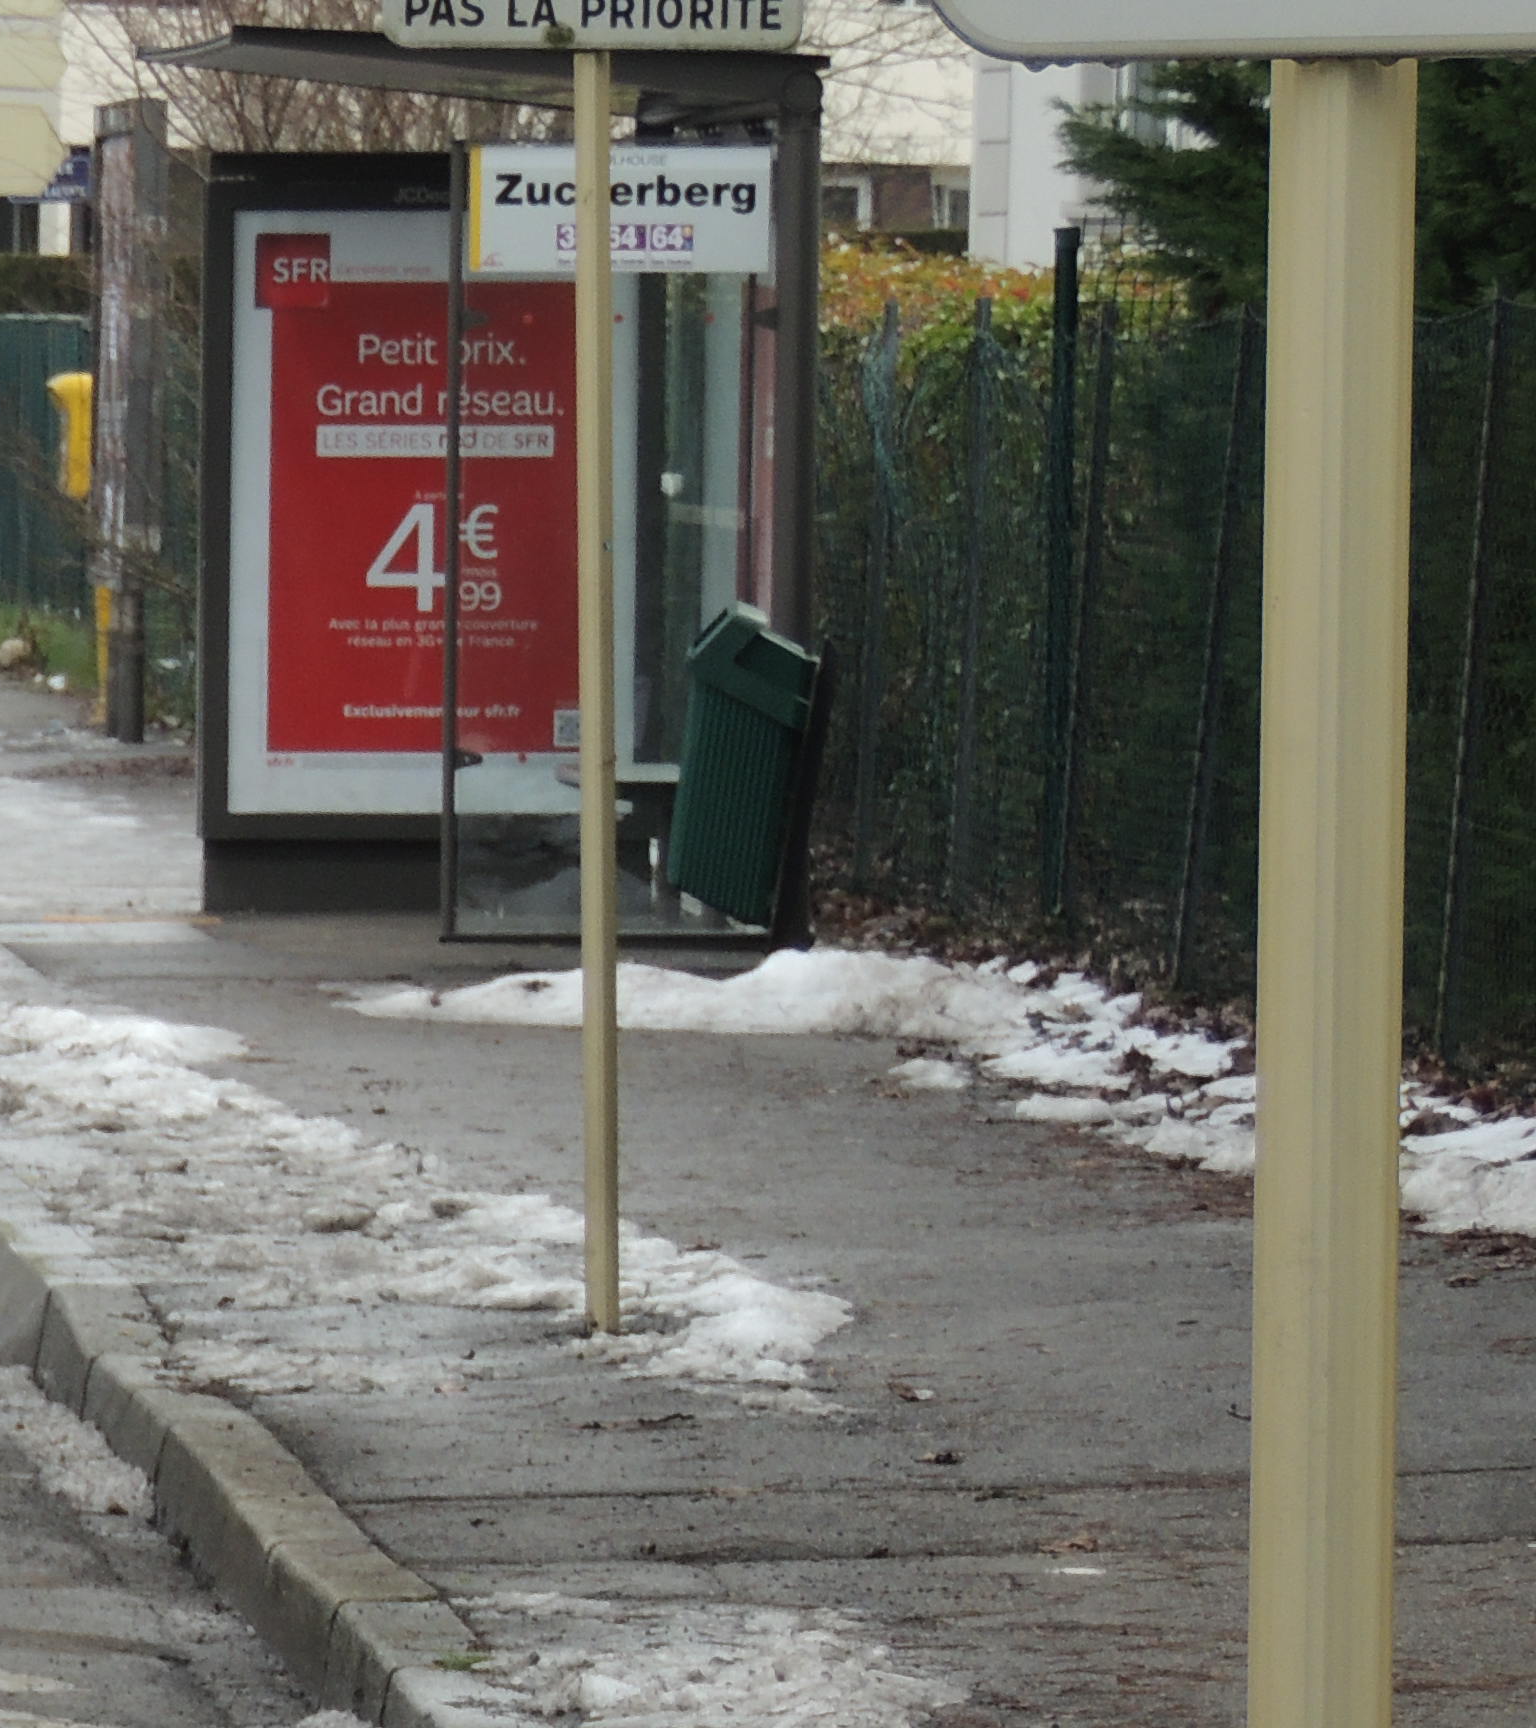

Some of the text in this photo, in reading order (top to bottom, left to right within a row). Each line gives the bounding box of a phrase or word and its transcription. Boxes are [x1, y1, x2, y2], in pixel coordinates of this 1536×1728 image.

[405, 0, 486, 27] PAS
[507, 0, 558, 28] LA
[495, 173, 757, 214] Zucerberg
[652, 226, 684, 249] 64
[272, 258, 329, 283] SFR
[358, 333, 439, 365] Petit
[316, 383, 423, 416] Grand
[323, 433, 358, 450] LES
[438, 431, 477, 451] rd
[482, 433, 505, 450] DE
[514, 432, 549, 450] SFR
[365, 503, 500, 612] 4 €
[458, 581, 502, 612] 99
[343, 703, 444, 718] Exclusivemen
